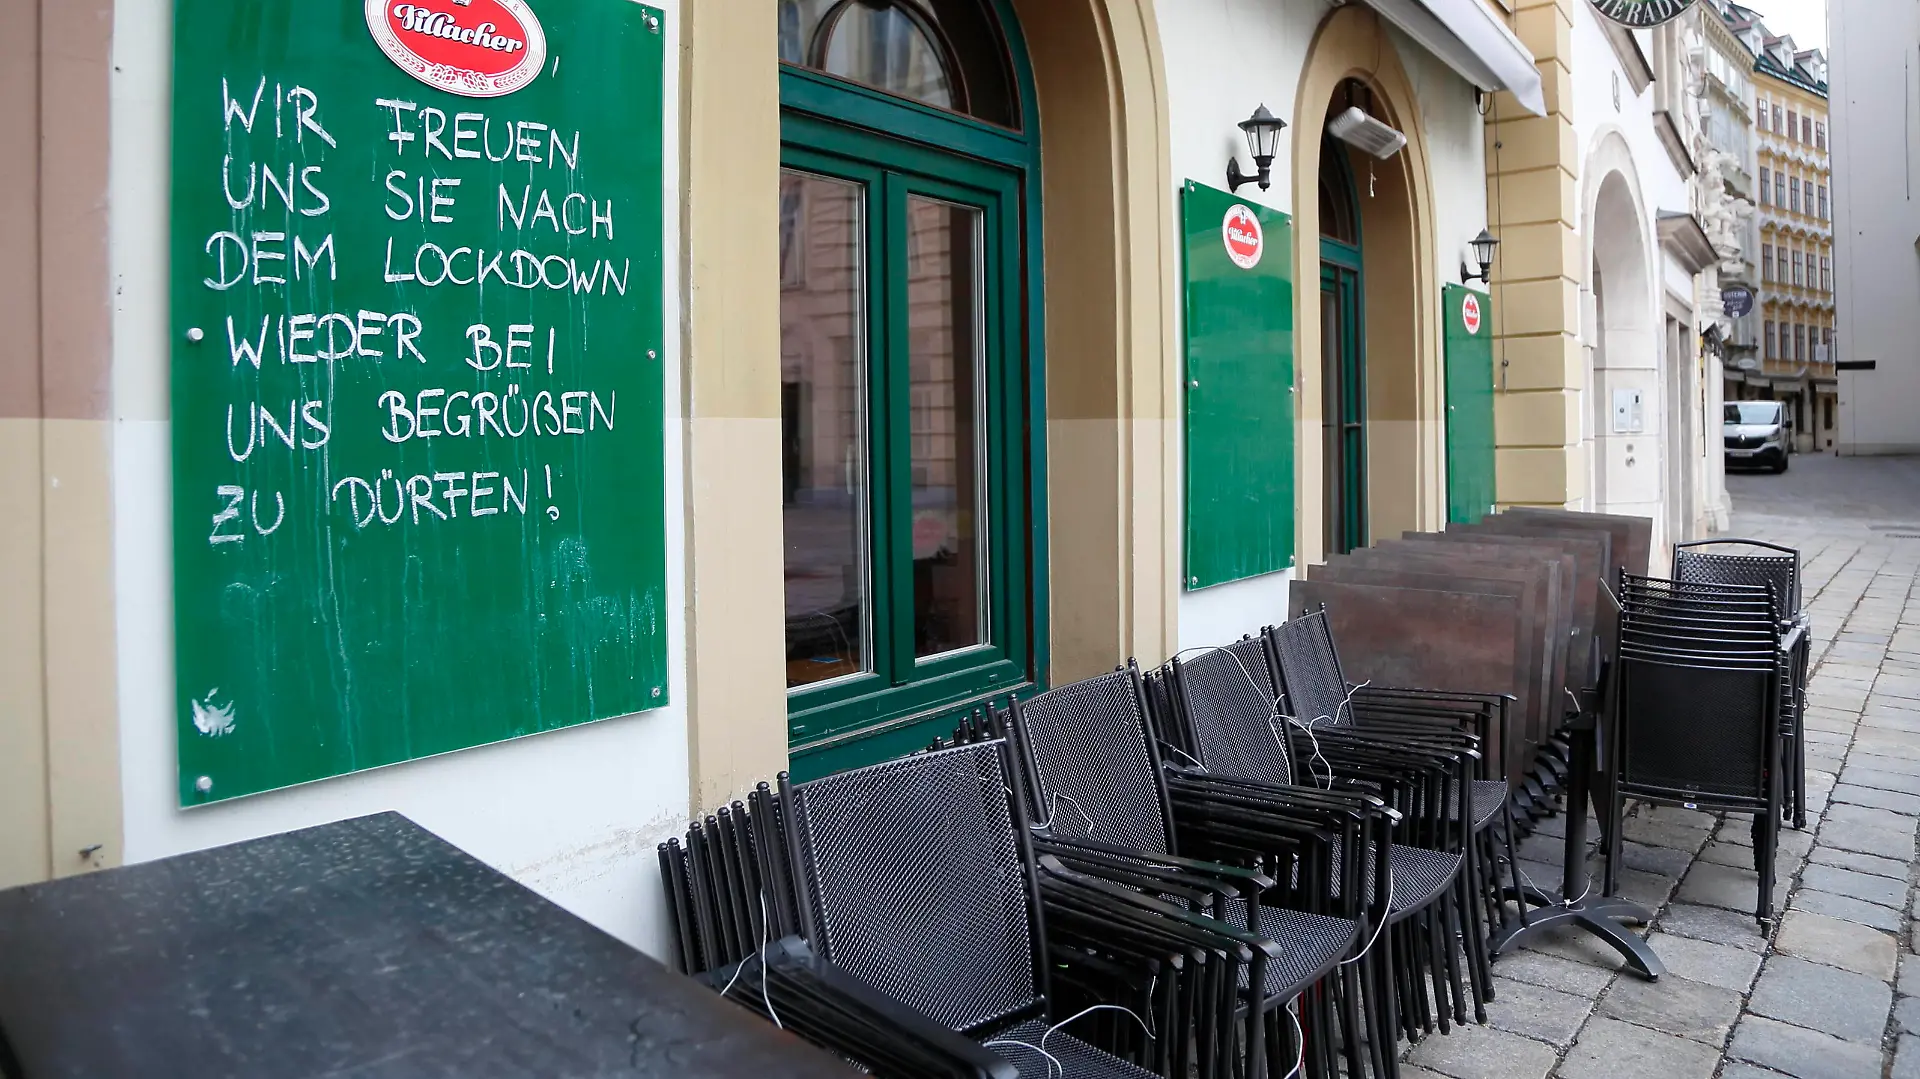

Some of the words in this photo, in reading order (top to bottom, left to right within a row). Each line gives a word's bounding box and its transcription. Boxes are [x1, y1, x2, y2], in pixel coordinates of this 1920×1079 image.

[393, 3, 523, 54] Villacher
[222, 75, 337, 149] WIR
[376, 98, 580, 169] FREUEN
[223, 153, 331, 217] UNS
[385, 170, 461, 224] SIE
[499, 183, 614, 241] NACH
[203, 230, 337, 291] DEM
[385, 236, 630, 296] LOCKDOWN
[226, 309, 427, 370] WIEDER
[465, 323, 556, 375] BEI
[226, 400, 331, 463] UNS
[209, 485, 286, 544] ZU
